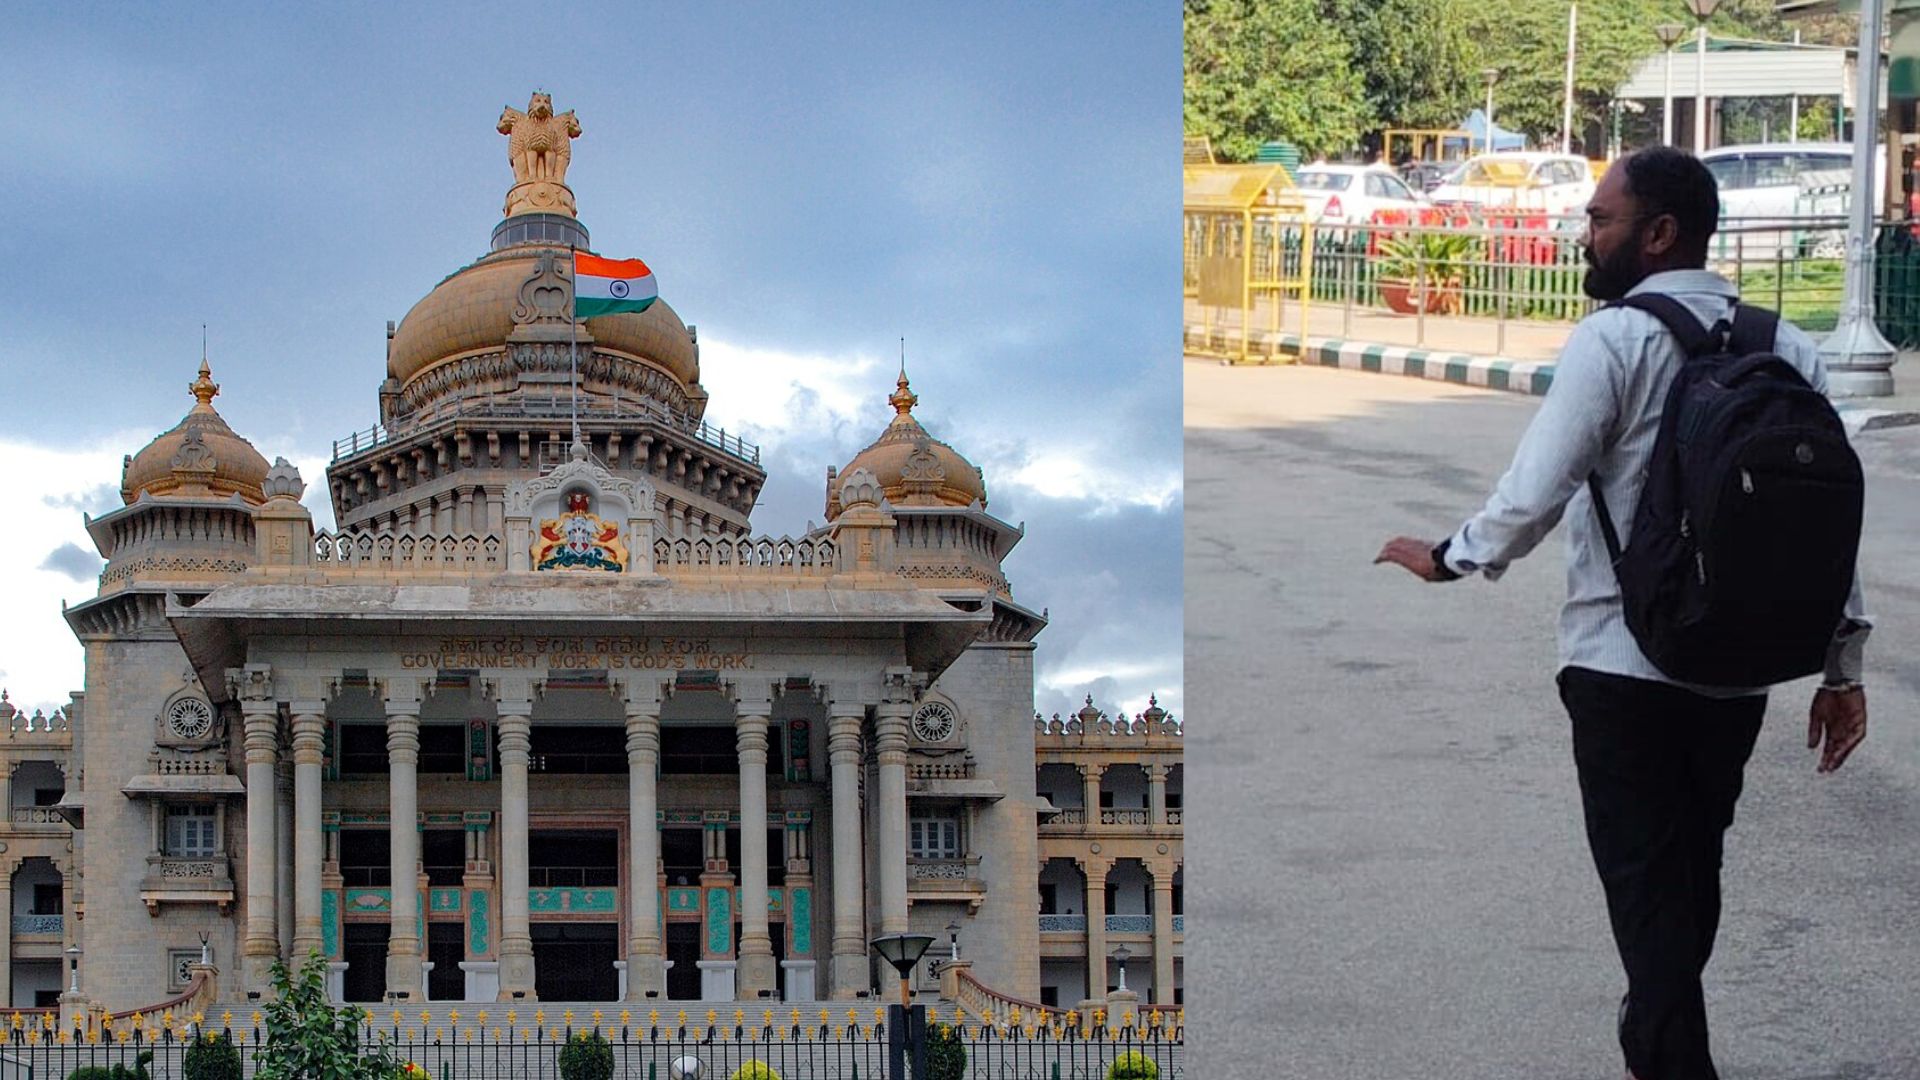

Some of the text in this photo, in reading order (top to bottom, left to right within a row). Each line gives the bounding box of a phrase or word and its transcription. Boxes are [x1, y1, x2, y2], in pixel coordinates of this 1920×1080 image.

[402, 653, 755, 669] GOVERNMENT WORK IS GOD'S WORK.
